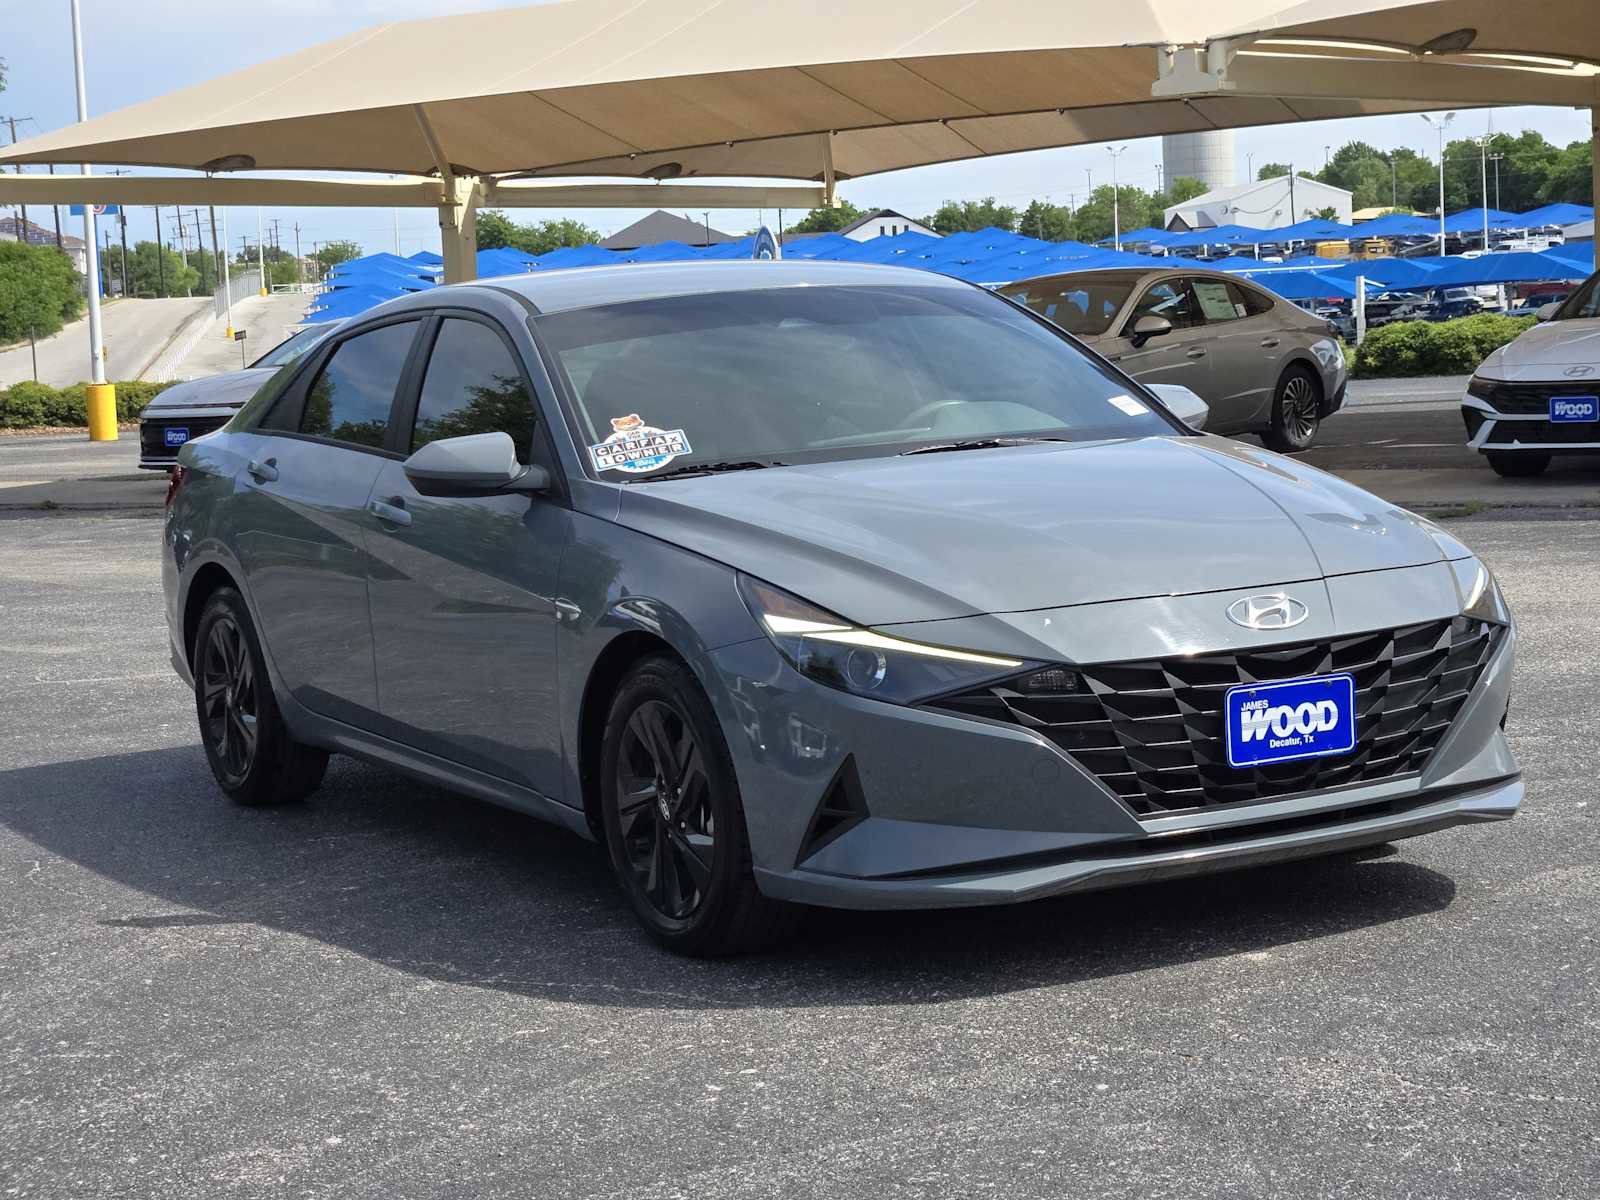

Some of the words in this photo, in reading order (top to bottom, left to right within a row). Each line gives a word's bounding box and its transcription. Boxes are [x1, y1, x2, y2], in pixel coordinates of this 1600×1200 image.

[1555, 403, 1592, 415] WOOD
[596, 436, 679, 456] CARFAX
[614, 443, 683, 463] OWNER
[1241, 699, 1269, 712] JAMES
[1241, 700, 1339, 743] WOOD
[1269, 737, 1303, 749] Decatur,
[1303, 734, 1315, 744] Tx
